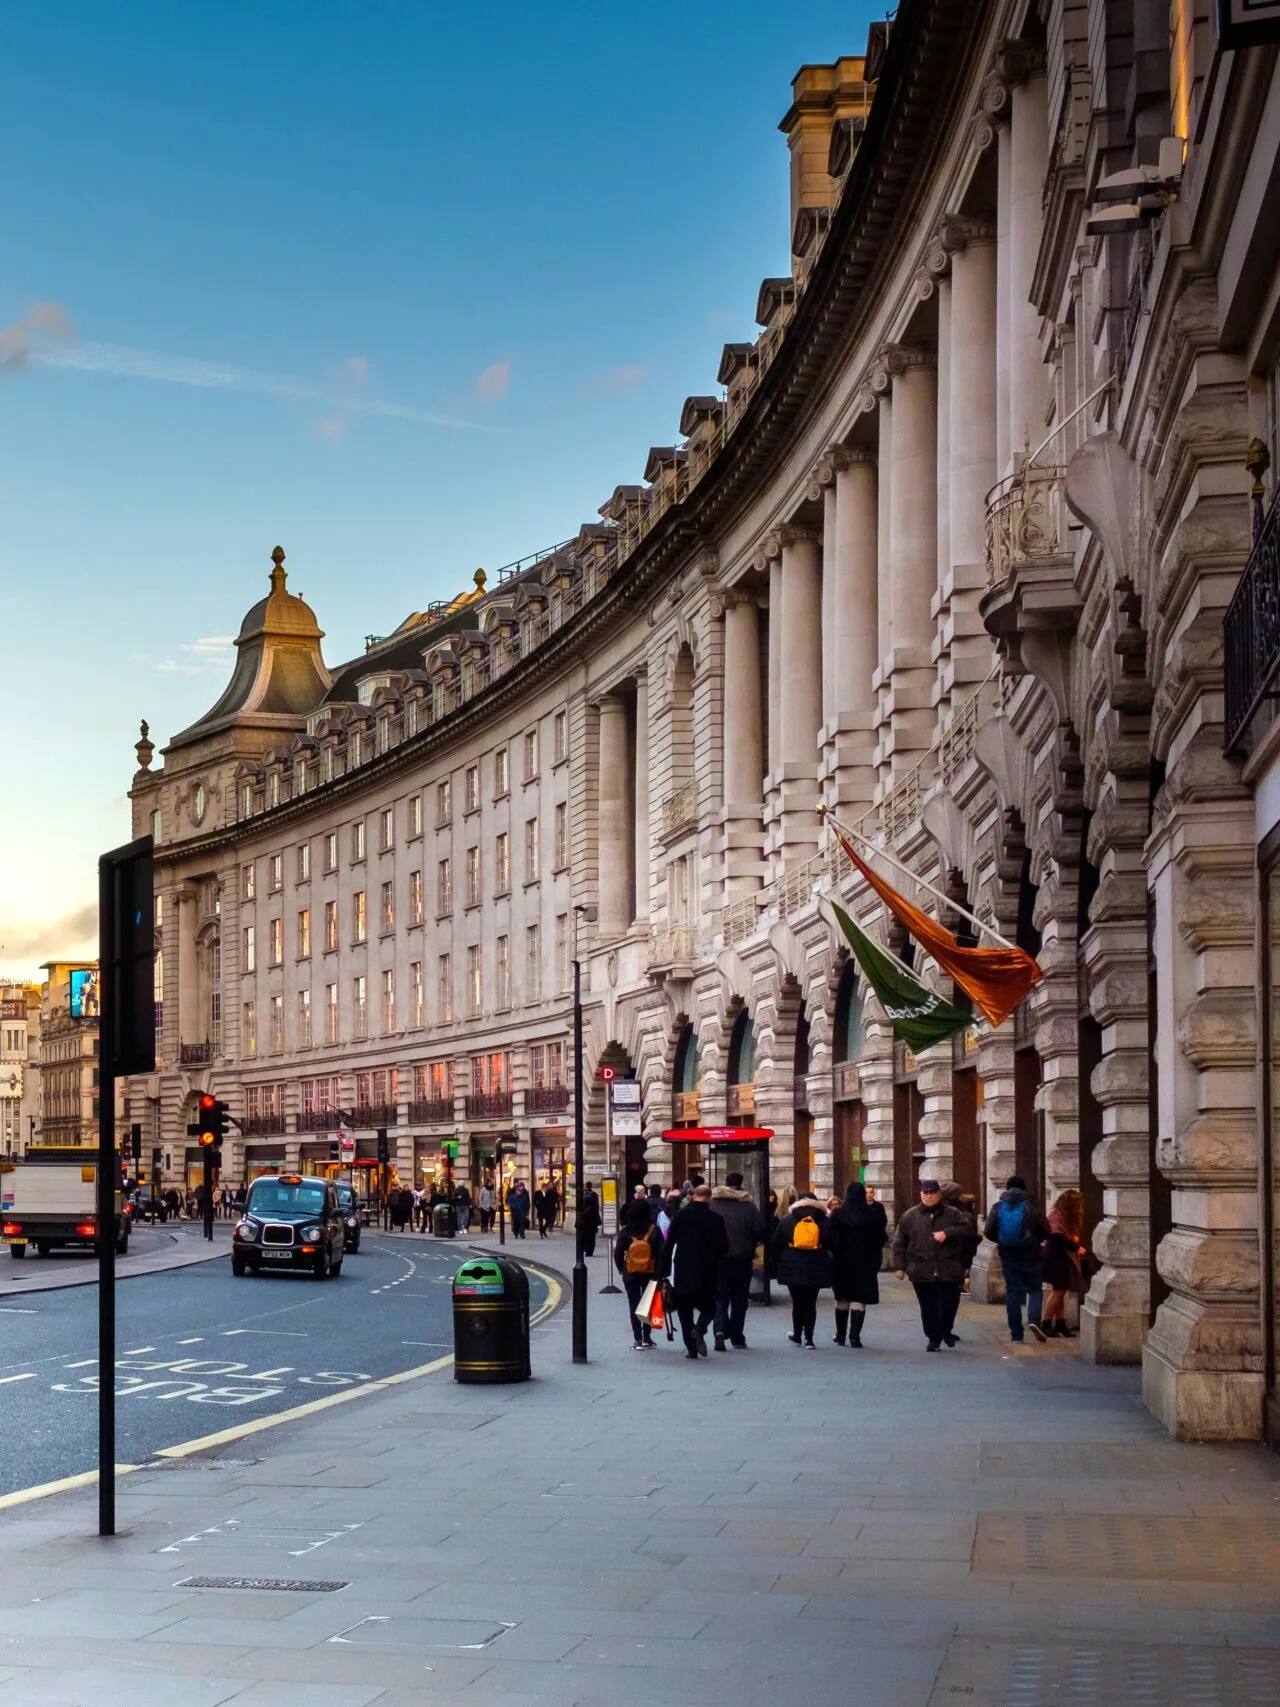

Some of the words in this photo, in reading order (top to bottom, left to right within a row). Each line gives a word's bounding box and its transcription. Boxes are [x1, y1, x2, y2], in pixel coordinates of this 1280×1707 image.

[604, 1068, 614, 1079] D
[115, 1358, 372, 1385] STOP
[51, 1375, 286, 1406] BUS
